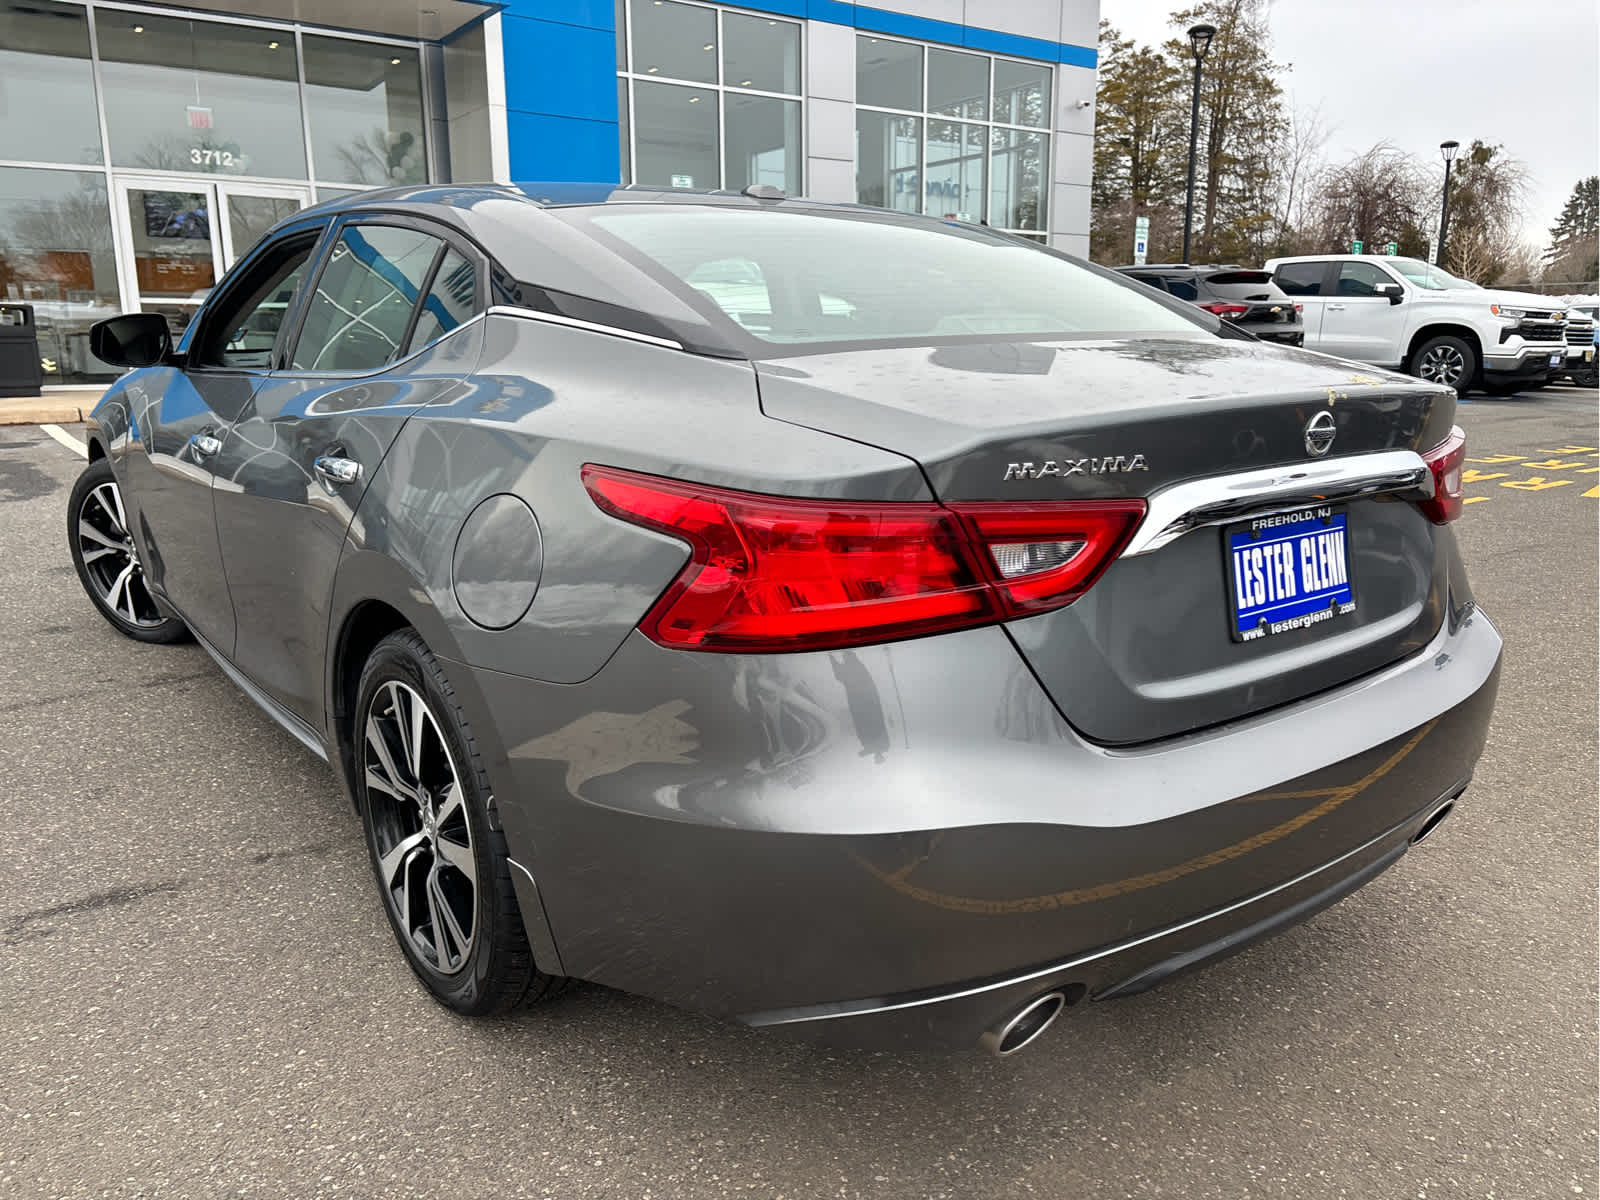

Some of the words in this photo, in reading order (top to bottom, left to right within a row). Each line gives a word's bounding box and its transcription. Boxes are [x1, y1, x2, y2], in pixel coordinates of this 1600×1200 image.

[191, 148, 233, 167] 3712
[1003, 454, 1149, 481] MAXIMA
[1252, 511, 1316, 530] FREEHOLD,
[1318, 507, 1331, 517] NJ
[1233, 541, 1296, 609] LESTER
[1299, 531, 1348, 594] GLENN
[1271, 609, 1333, 635] lesterglenn
